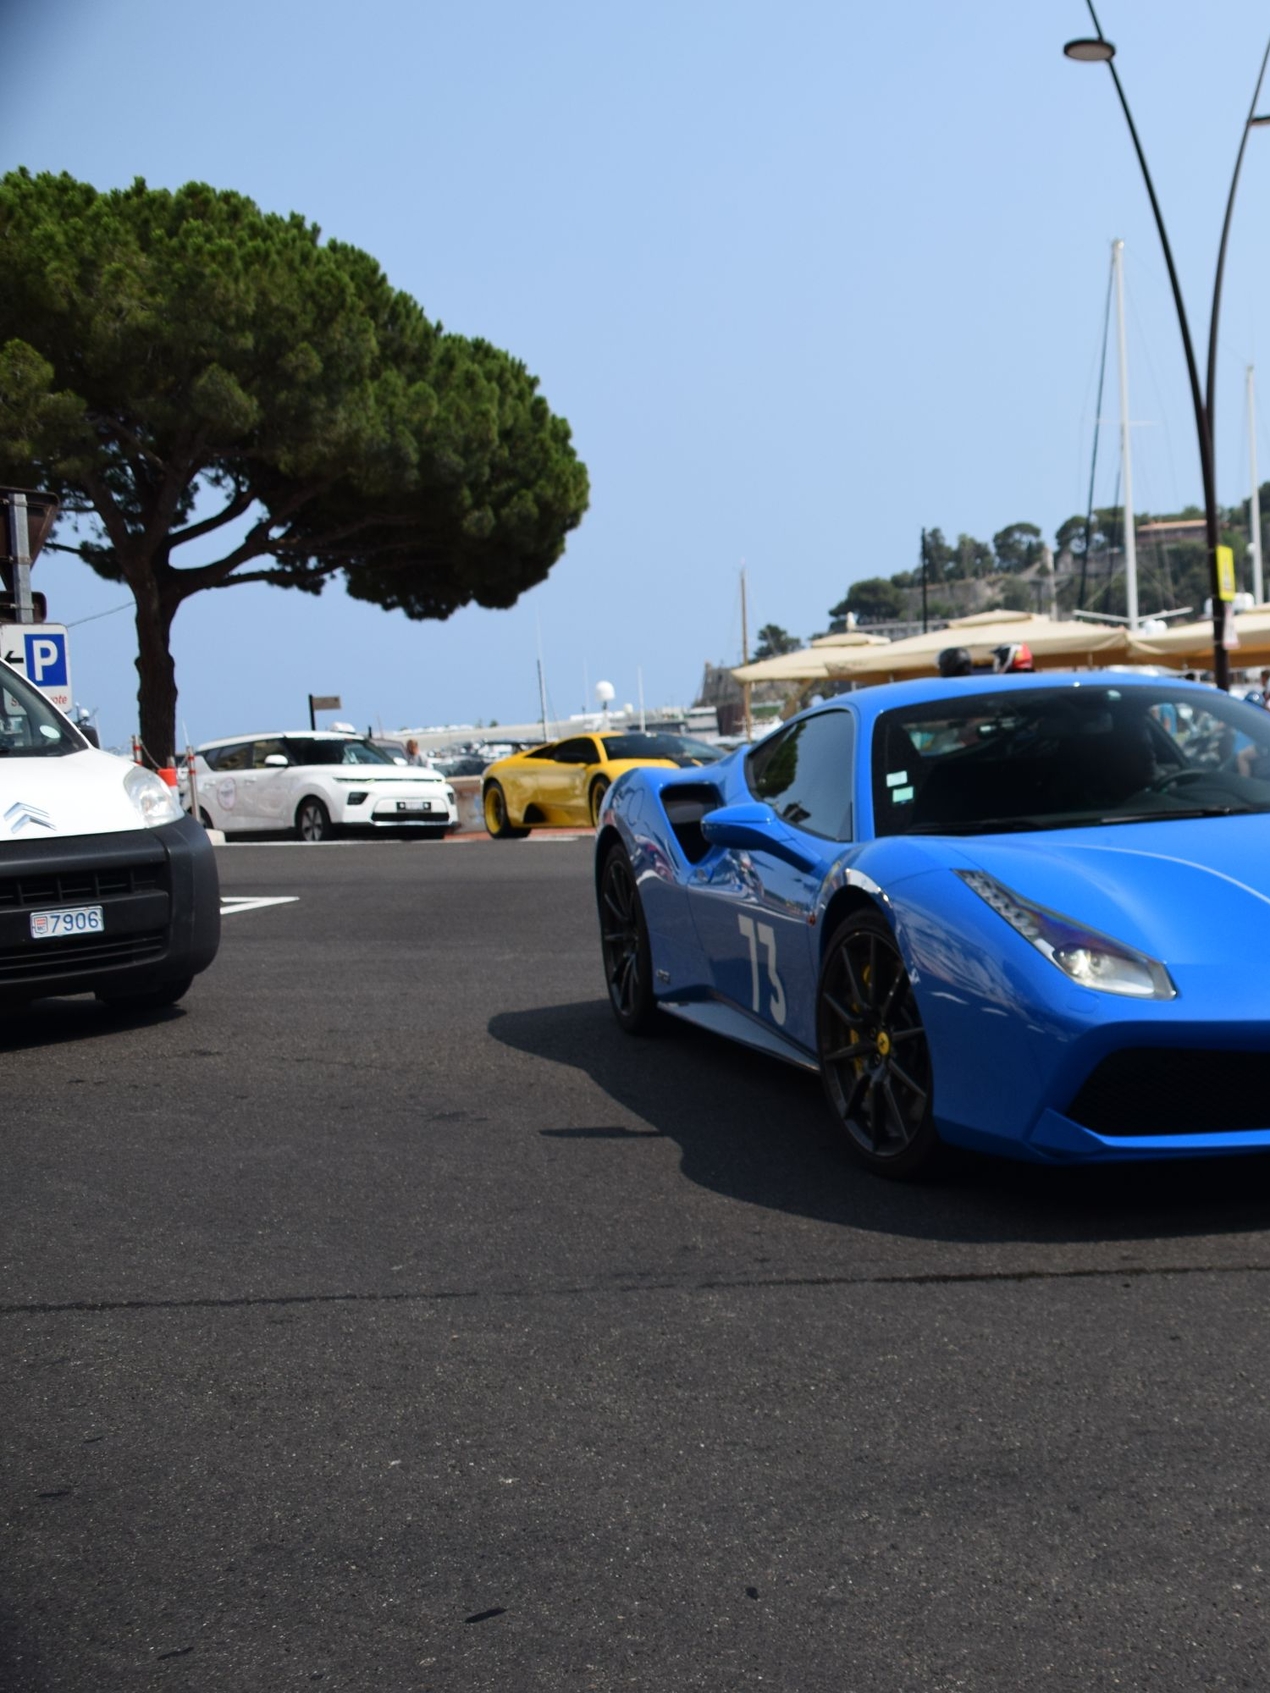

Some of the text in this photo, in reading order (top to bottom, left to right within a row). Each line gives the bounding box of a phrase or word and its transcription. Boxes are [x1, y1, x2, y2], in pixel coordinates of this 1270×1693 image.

[32, 639, 58, 682] P
[50, 911, 99, 934] 7906
[737, 913, 787, 1026] 73
